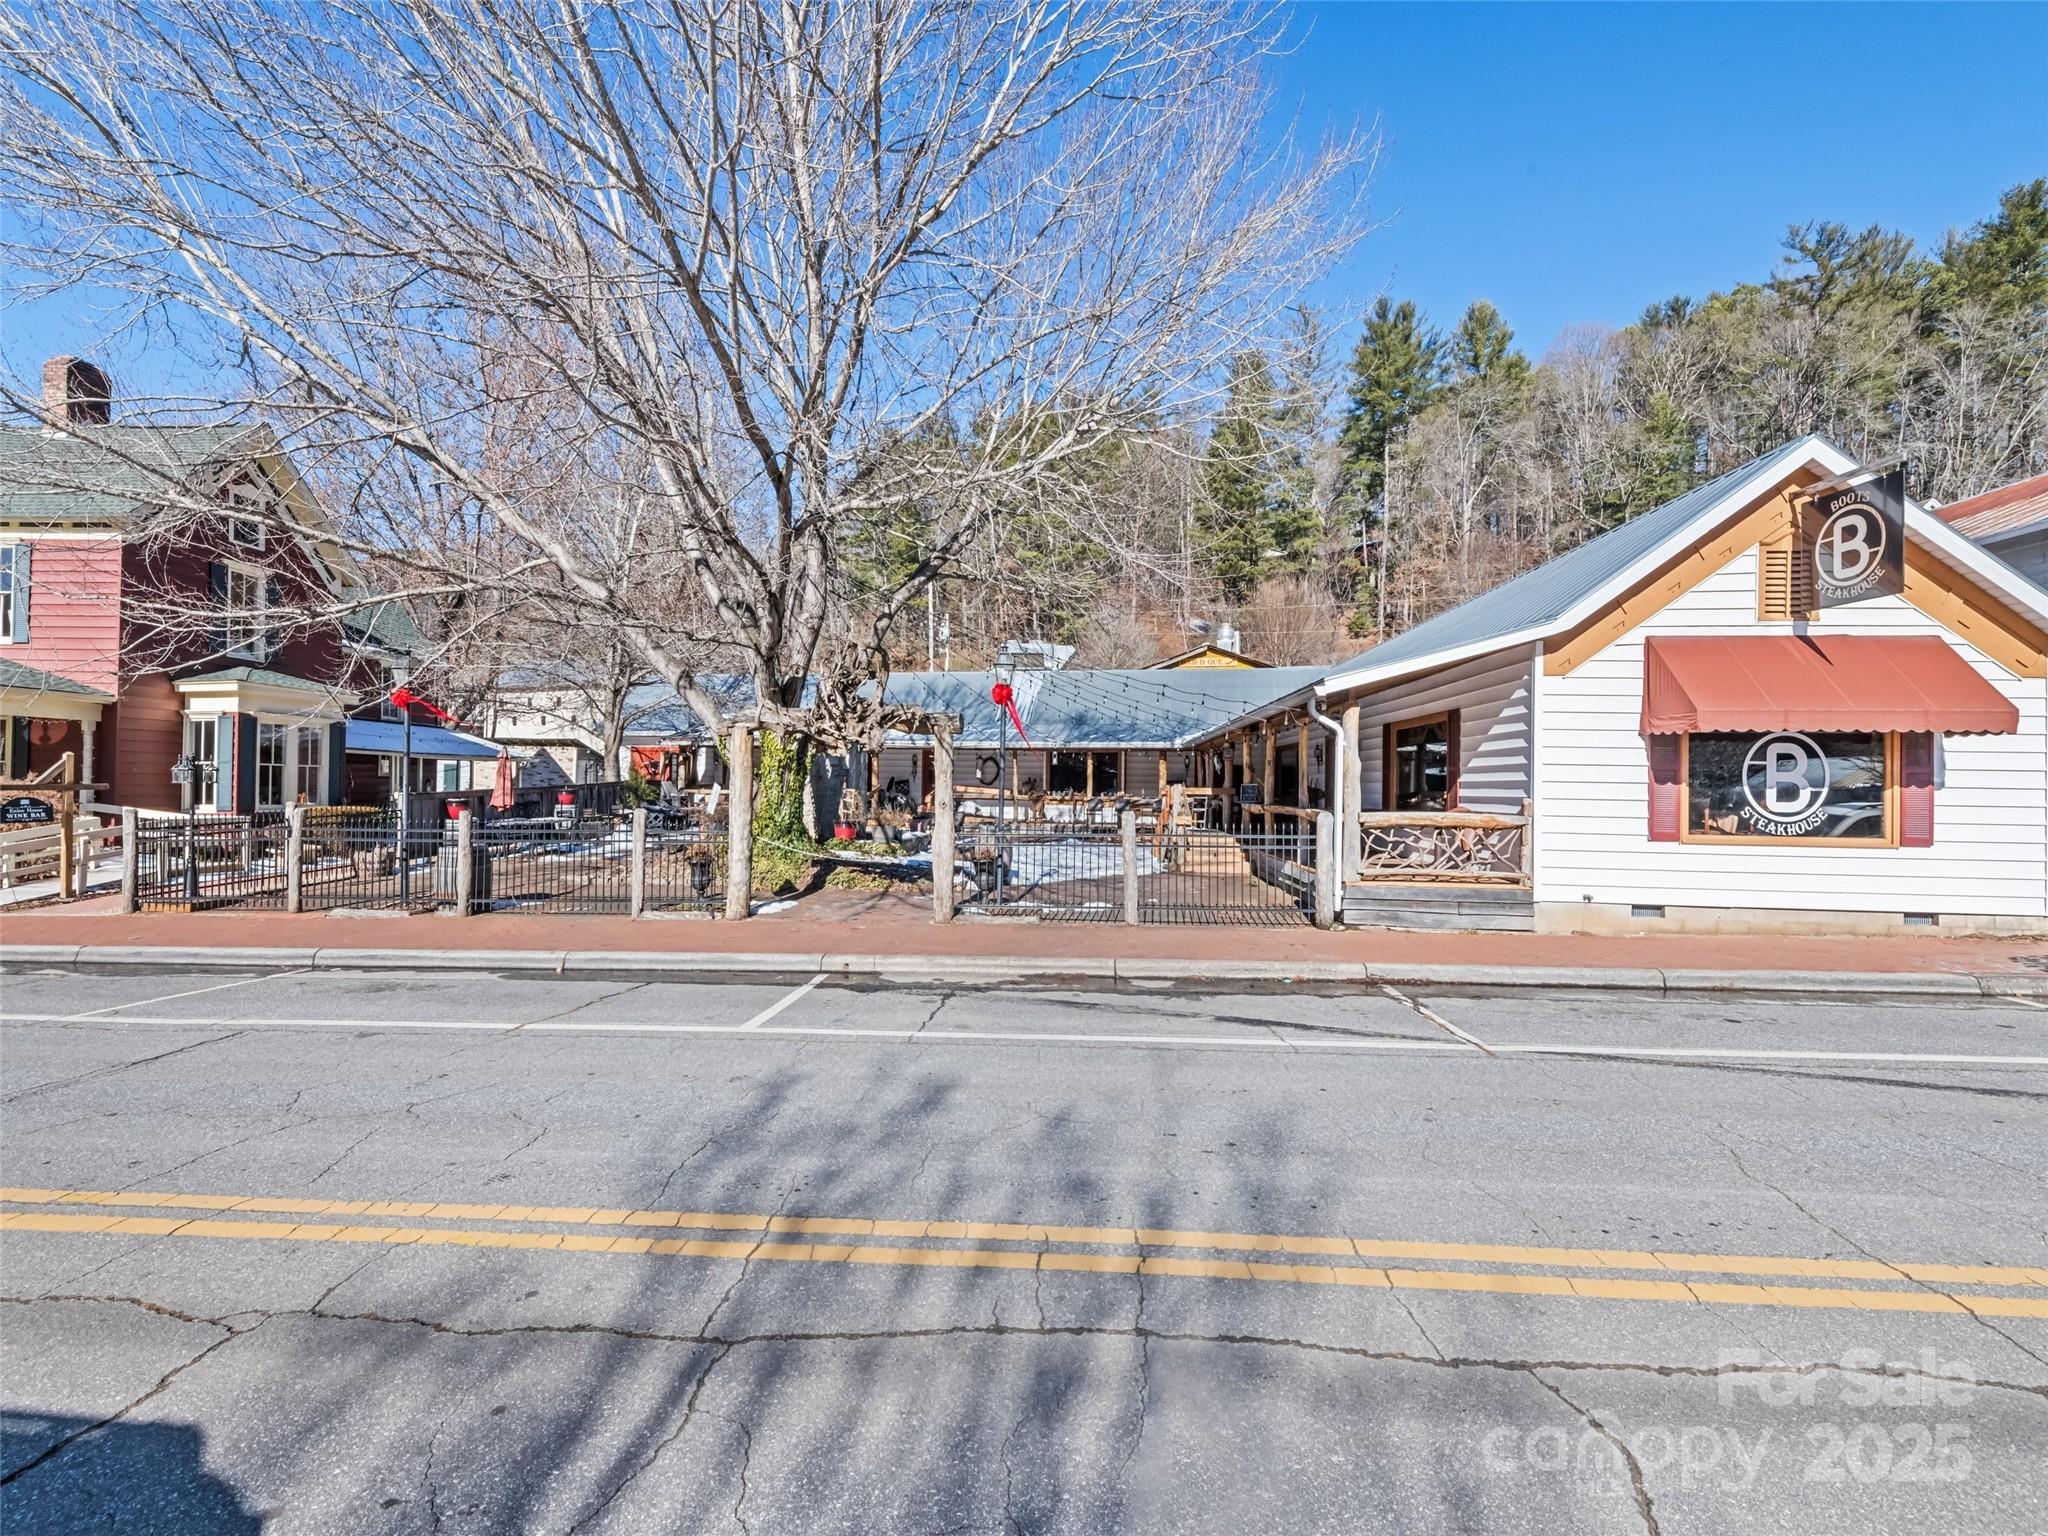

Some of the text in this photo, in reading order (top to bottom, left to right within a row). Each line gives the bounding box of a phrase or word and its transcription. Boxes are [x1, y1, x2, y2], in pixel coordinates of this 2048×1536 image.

[1830, 490, 1871, 512] BOOTS
[1833, 514, 1869, 579] B
[1815, 566, 1886, 599] STEAKHOUSE
[1765, 742, 1811, 813] B
[1740, 806, 1829, 837] STEAKHOUSE
